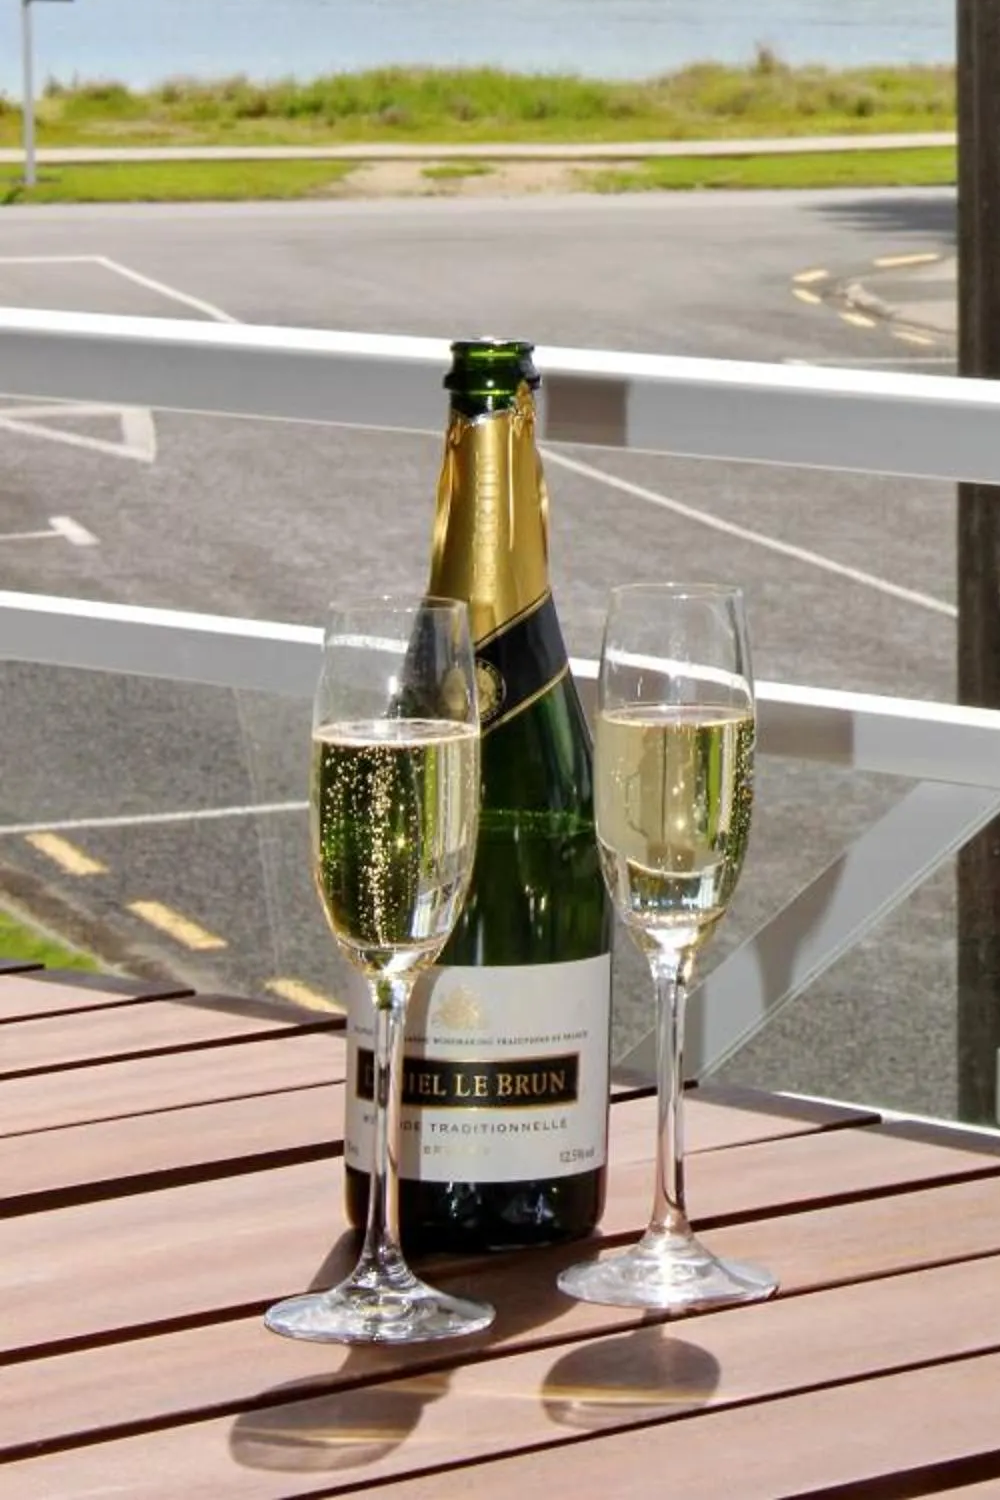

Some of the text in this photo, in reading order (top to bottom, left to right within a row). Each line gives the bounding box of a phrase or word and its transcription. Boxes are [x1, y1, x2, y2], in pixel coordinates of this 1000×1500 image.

[455, 1073, 488, 1097] LE
[496, 1069, 566, 1096] BRUN
[430, 1117, 568, 1134] TRADITIONNELLE
